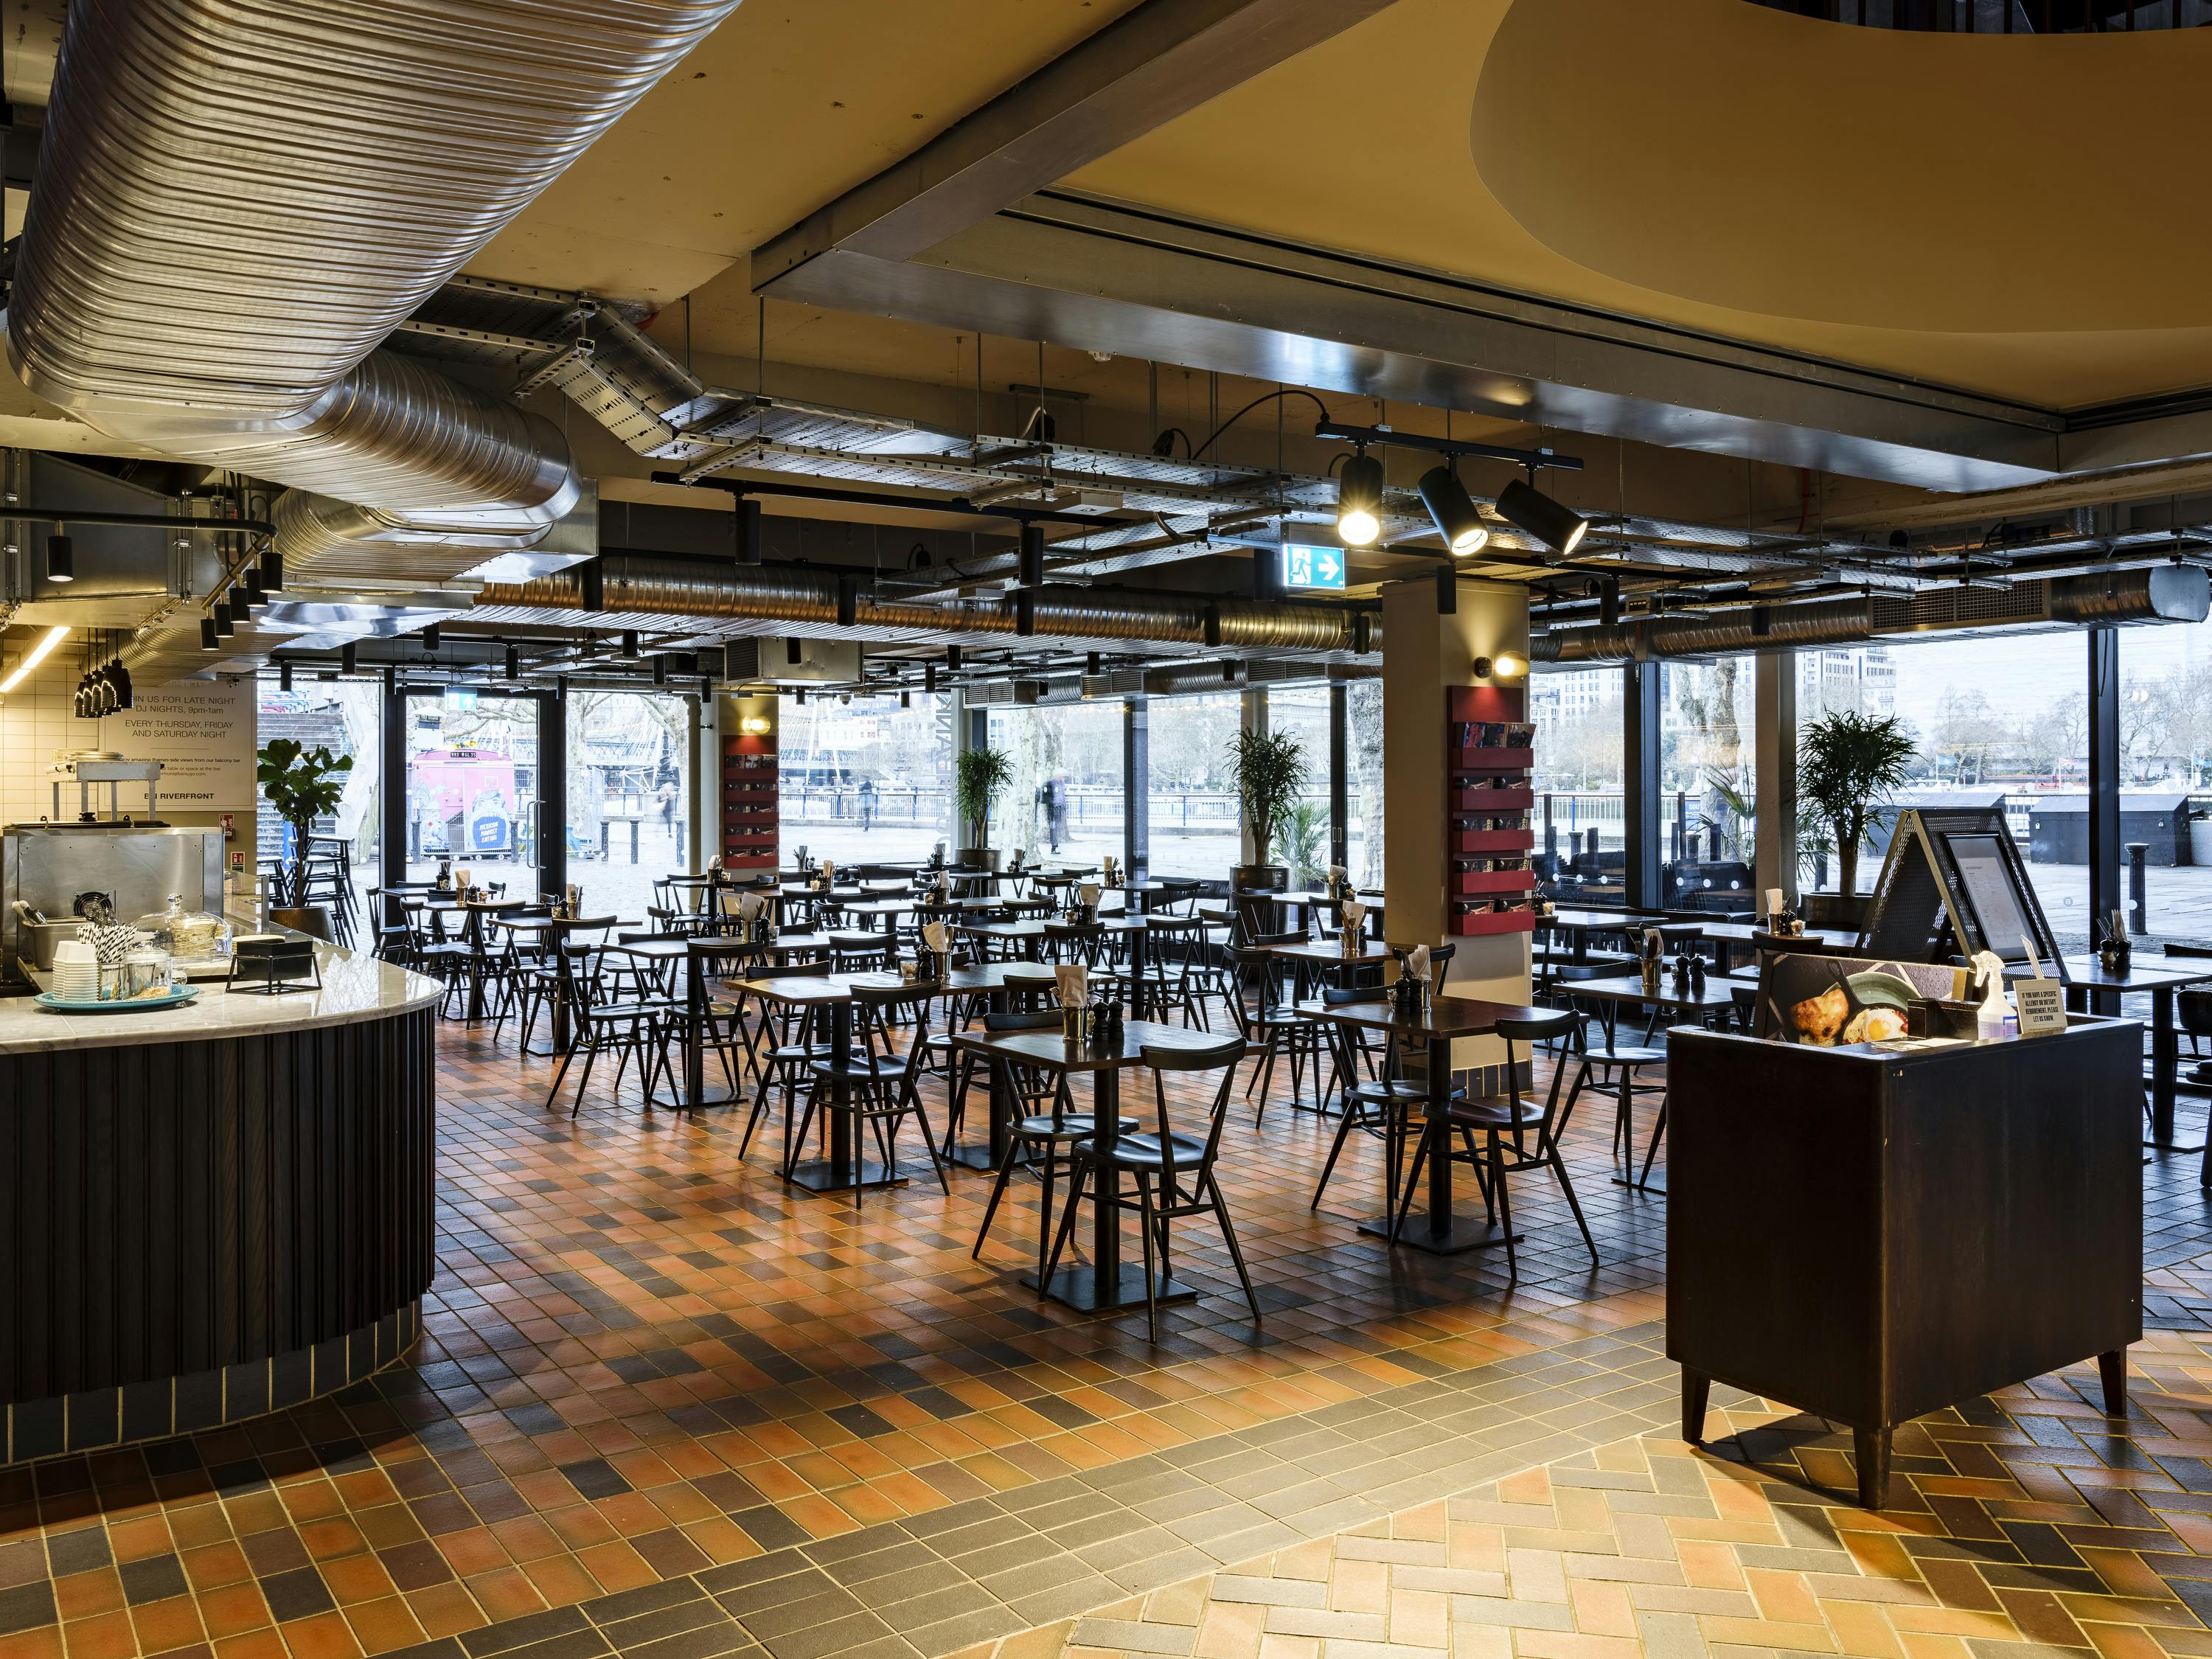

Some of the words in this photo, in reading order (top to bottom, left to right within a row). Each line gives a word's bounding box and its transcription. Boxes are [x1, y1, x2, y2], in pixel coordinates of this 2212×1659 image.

[150, 706, 186, 714] NIGHTS,
[188, 707, 223, 715] 9pm-1am
[156, 720, 202, 729] THURSDAY,
[204, 721, 234, 729] FRIDAY
[154, 730, 198, 738] SATURDAY
[480, 821, 498, 830] MEXICAN
[481, 828, 498, 837] MARKET
